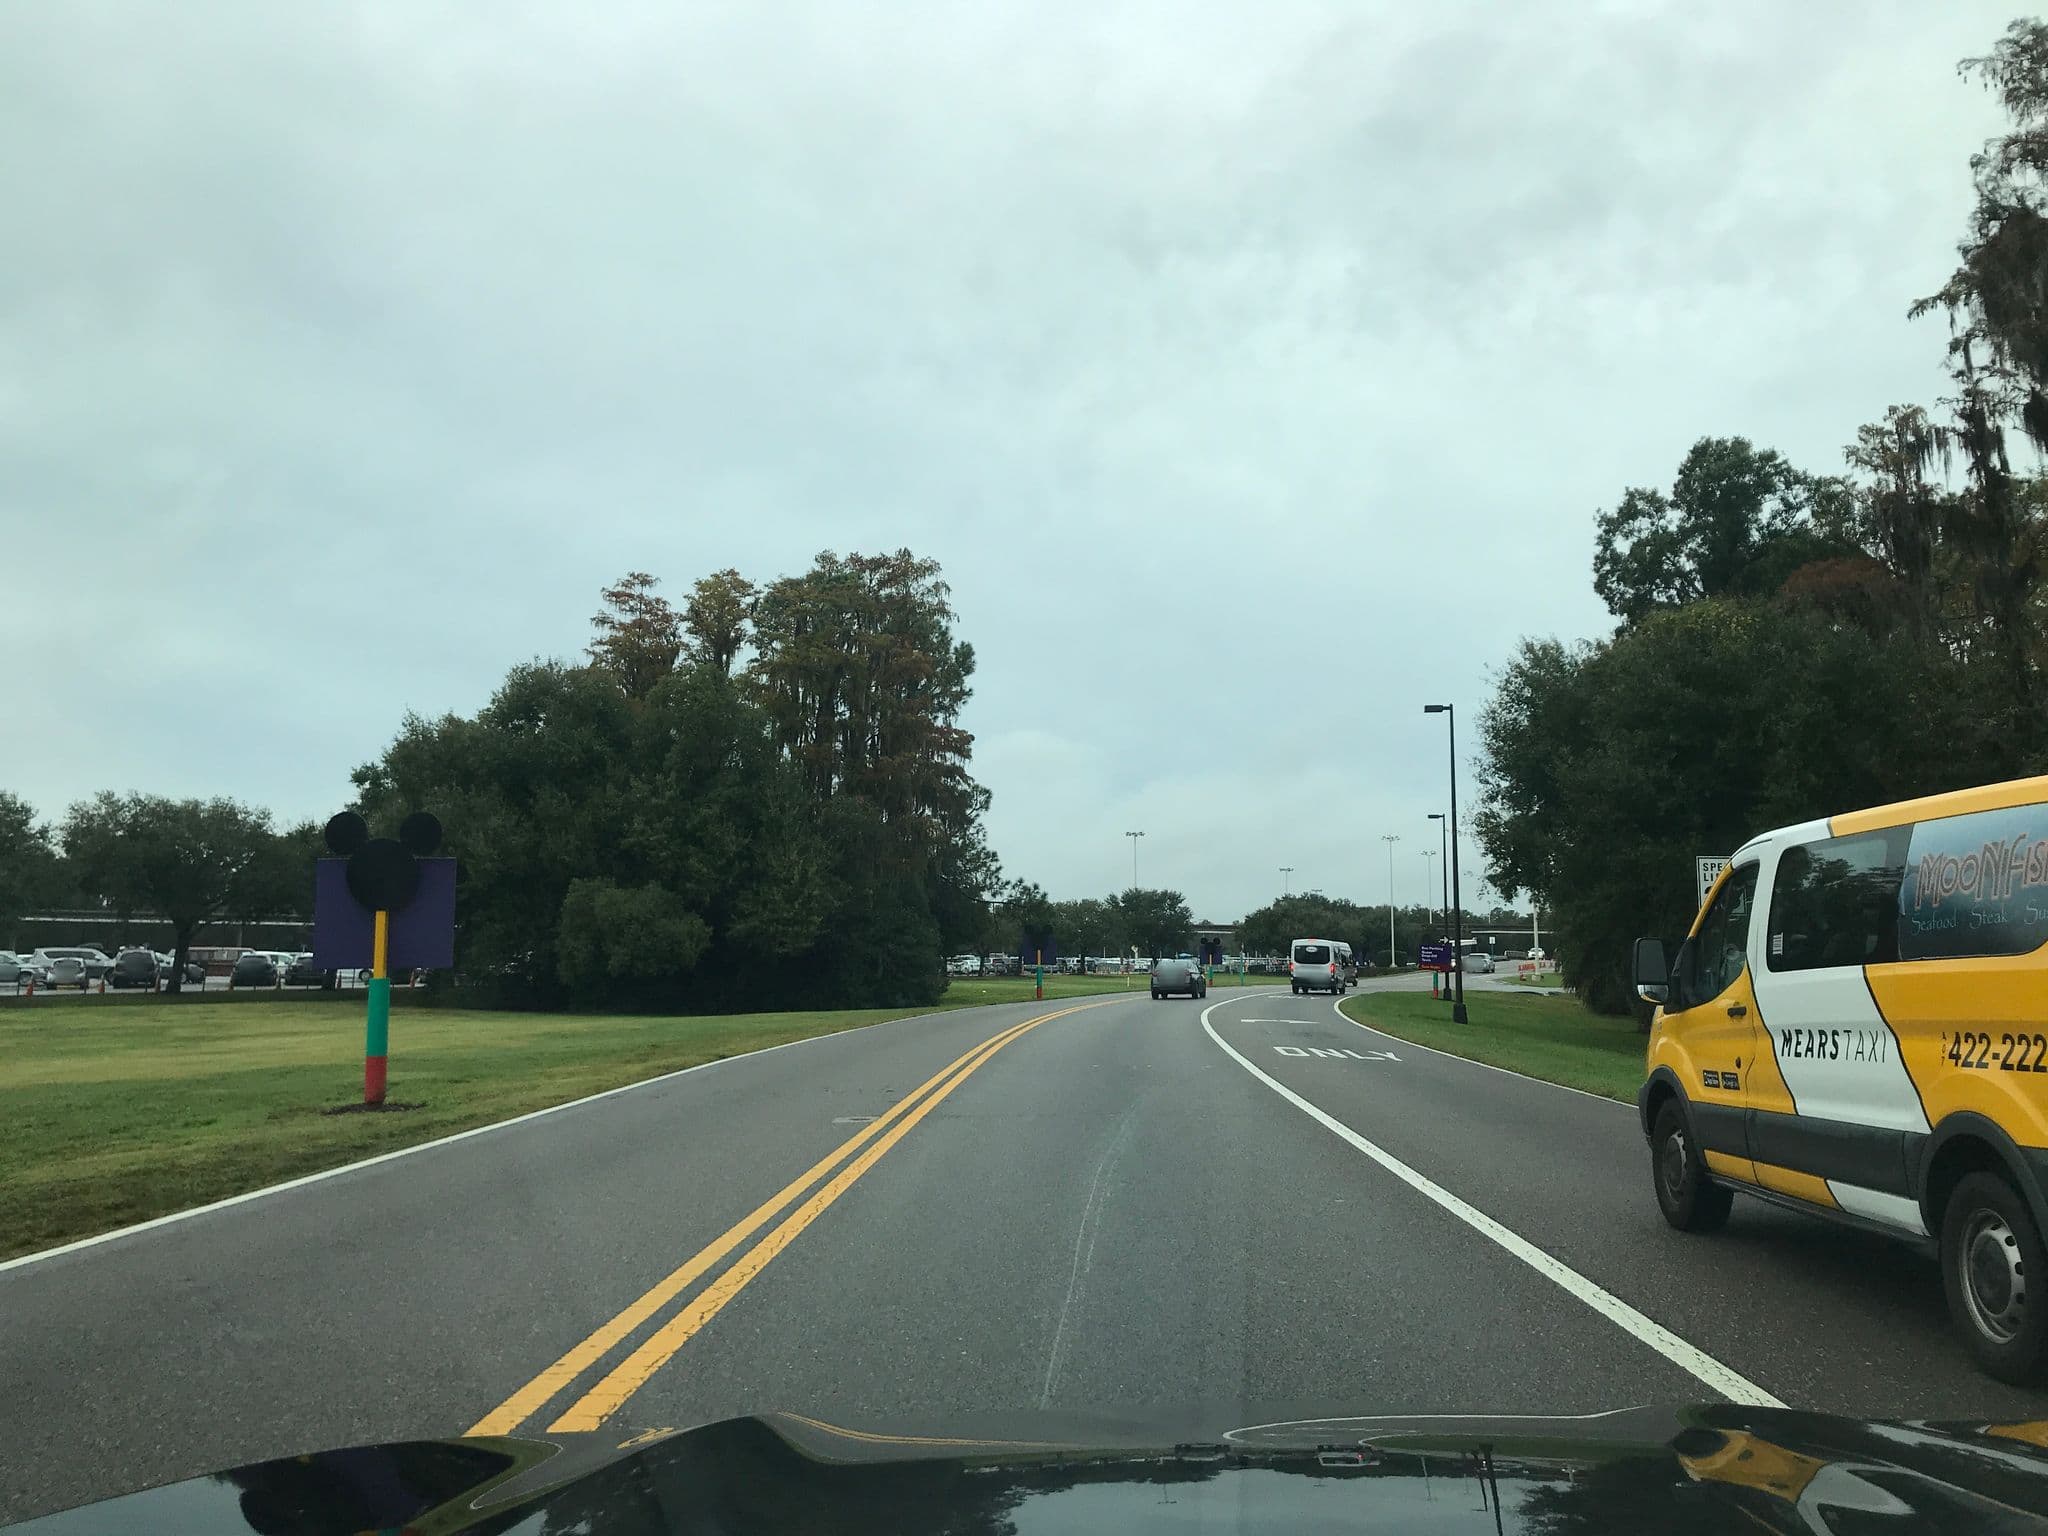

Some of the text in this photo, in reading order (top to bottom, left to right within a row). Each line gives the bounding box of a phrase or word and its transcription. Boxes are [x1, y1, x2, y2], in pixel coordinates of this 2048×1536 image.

[1703, 862, 1723, 872] SPE
[1911, 908, 1958, 936] Seafood
[1968, 902, 2008, 930] Steak
[1272, 1046, 1404, 1062] ONLY
